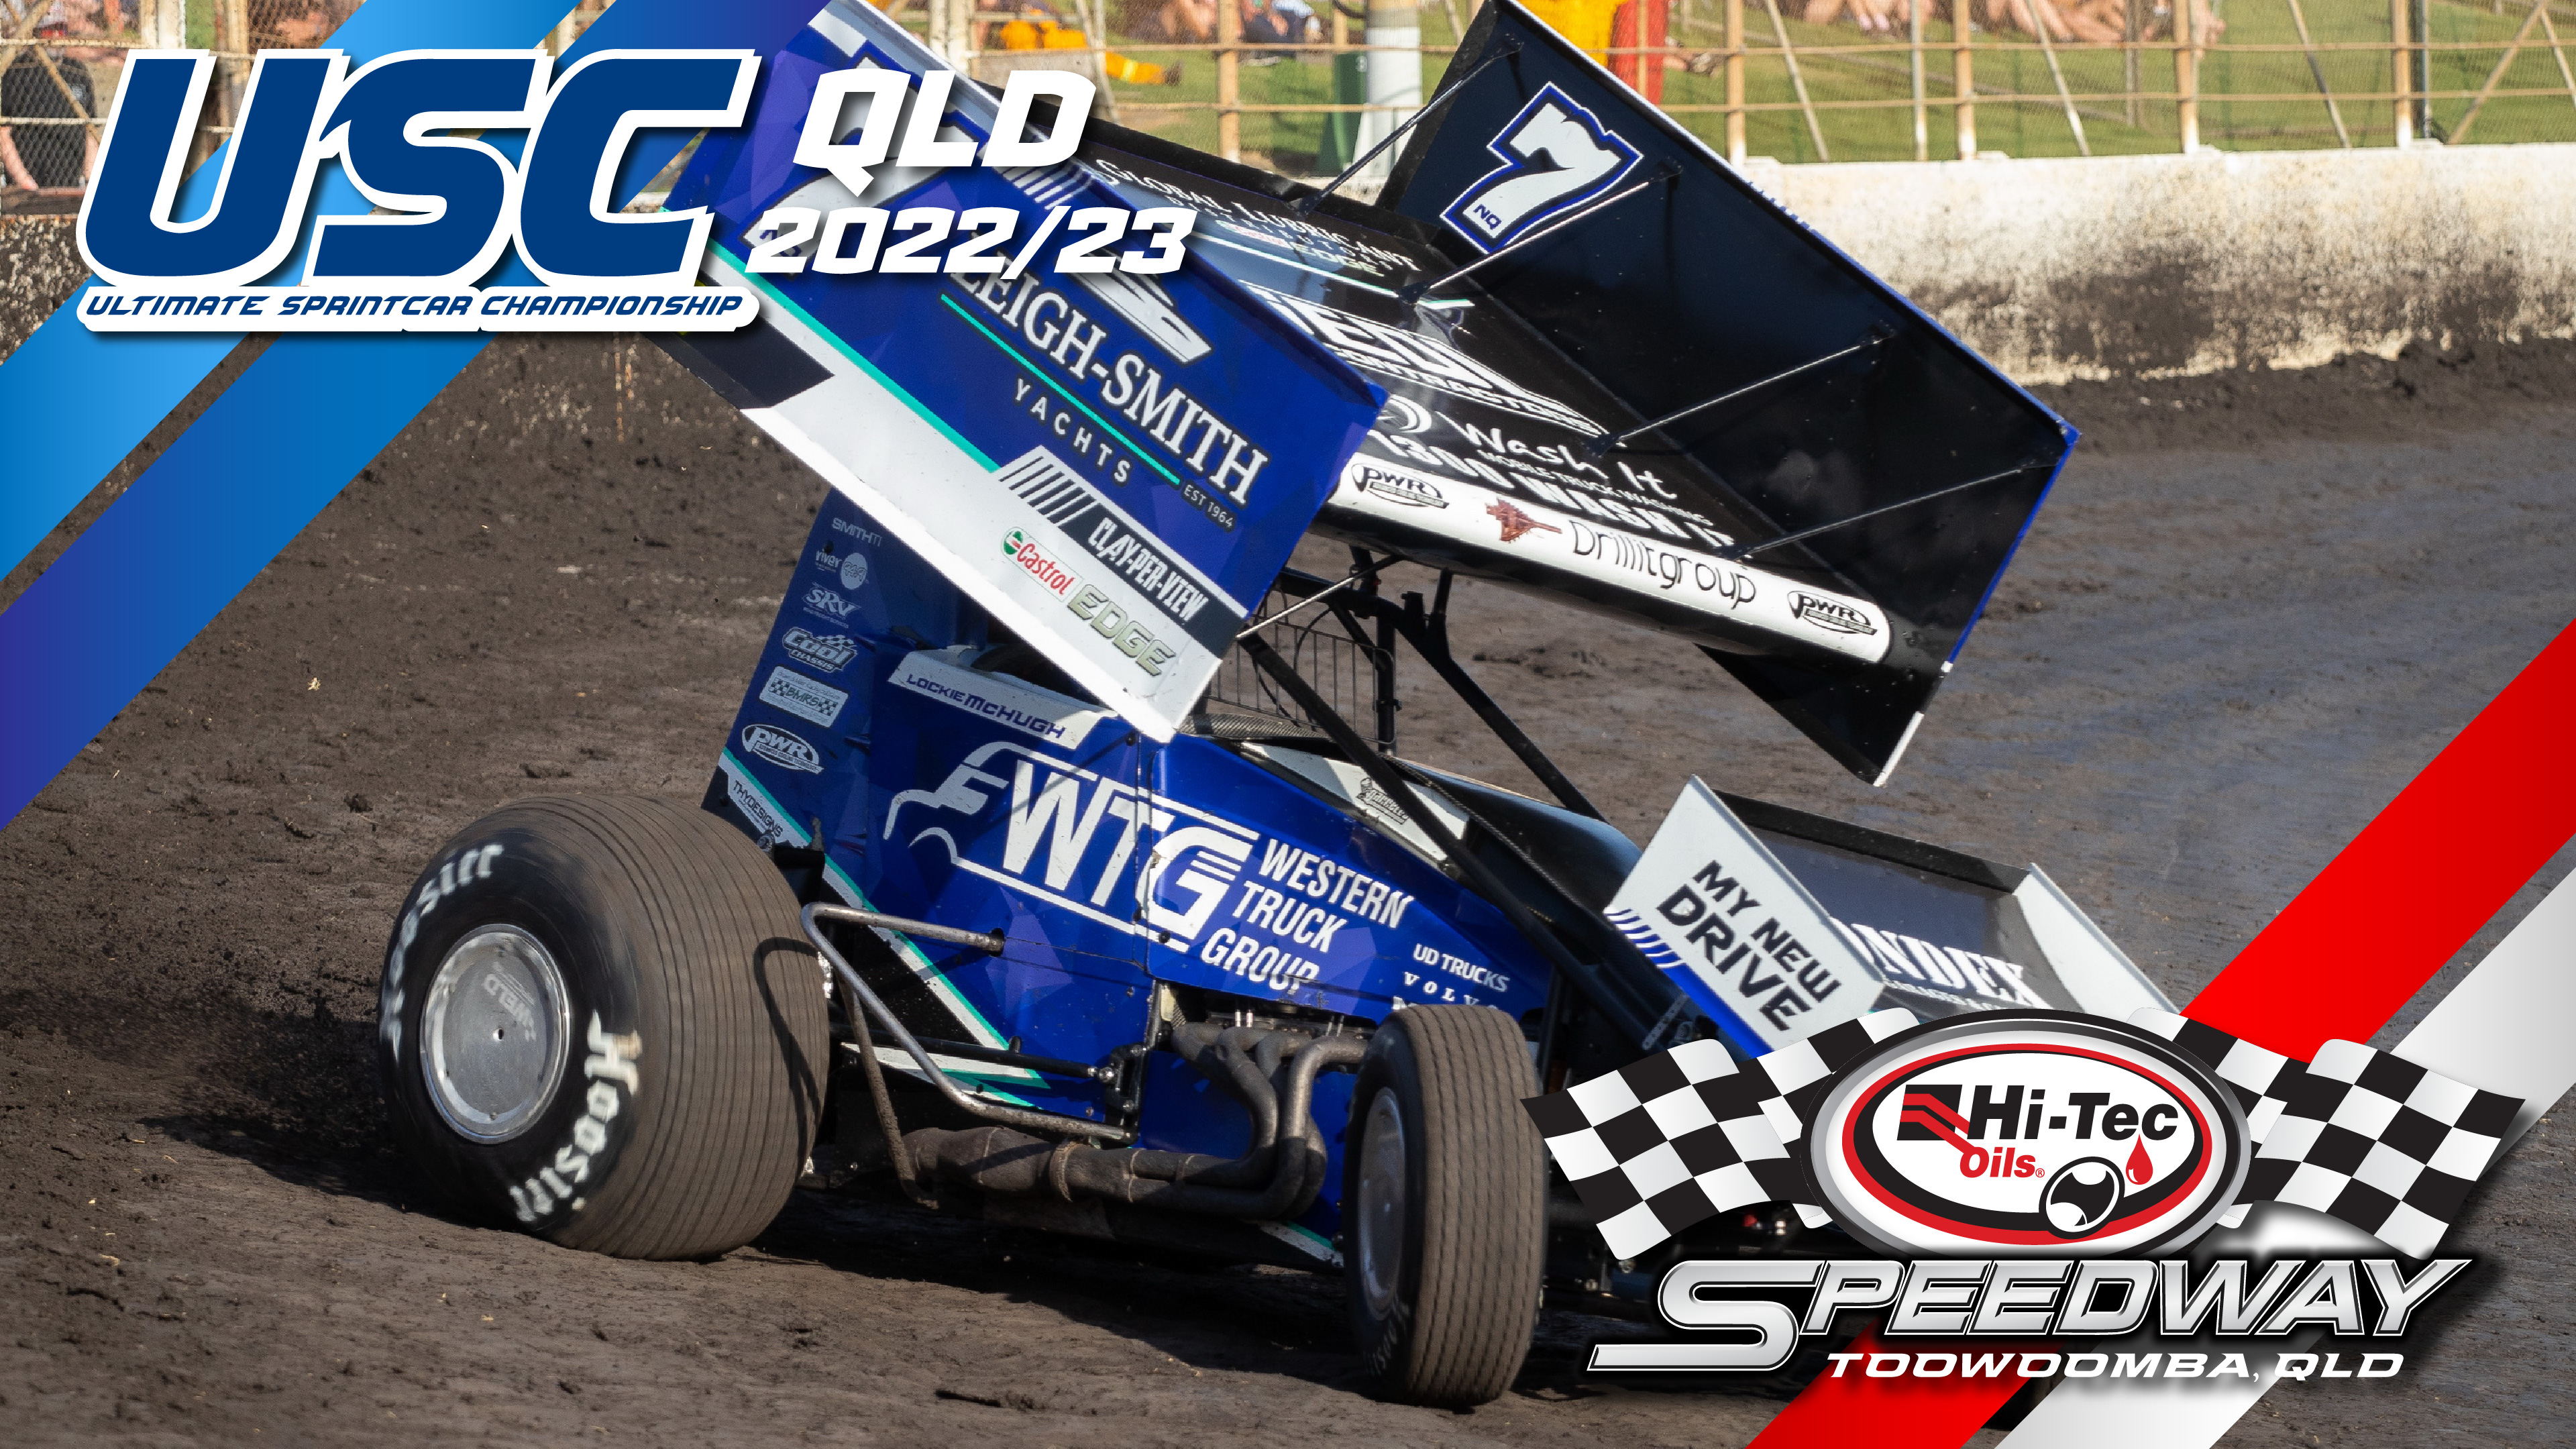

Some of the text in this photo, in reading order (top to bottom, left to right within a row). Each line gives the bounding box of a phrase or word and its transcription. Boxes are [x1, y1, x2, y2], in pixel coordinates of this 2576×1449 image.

[1456, 96, 1629, 244] 7
[1096, 159, 1421, 271] GLOBAL LUBRICANT
[1472, 203, 1502, 230] NQ
[1014, 379, 1130, 484] YACHTS
[1435, 411, 1677, 499] Wash It
[1183, 484, 1235, 529] EST 1964
[1509, 471, 1691, 539] WASH
[805, 587, 857, 616] SRV
[1087, 517, 1209, 621] CLAY-PER-VIEW
[1016, 542, 1177, 676] Castrol EDGE
[786, 687, 820, 706] BMRS
[907, 673, 964, 702] LOCKIE
[747, 727, 809, 761] PWR
[733, 780, 784, 837] THYDESIGNS
[1002, 760, 1253, 941] WTG
[1258, 839, 1415, 928] WESTERN
[1232, 880, 1348, 953] TRUCK
[1693, 859, 1843, 1002] MY NEW
[1201, 927, 1320, 995] GROUP
[1404, 971, 1498, 1010] VOLV
[1413, 943, 1510, 992] UD TRUCKS
[1656, 885, 1815, 1031] DRIVE
